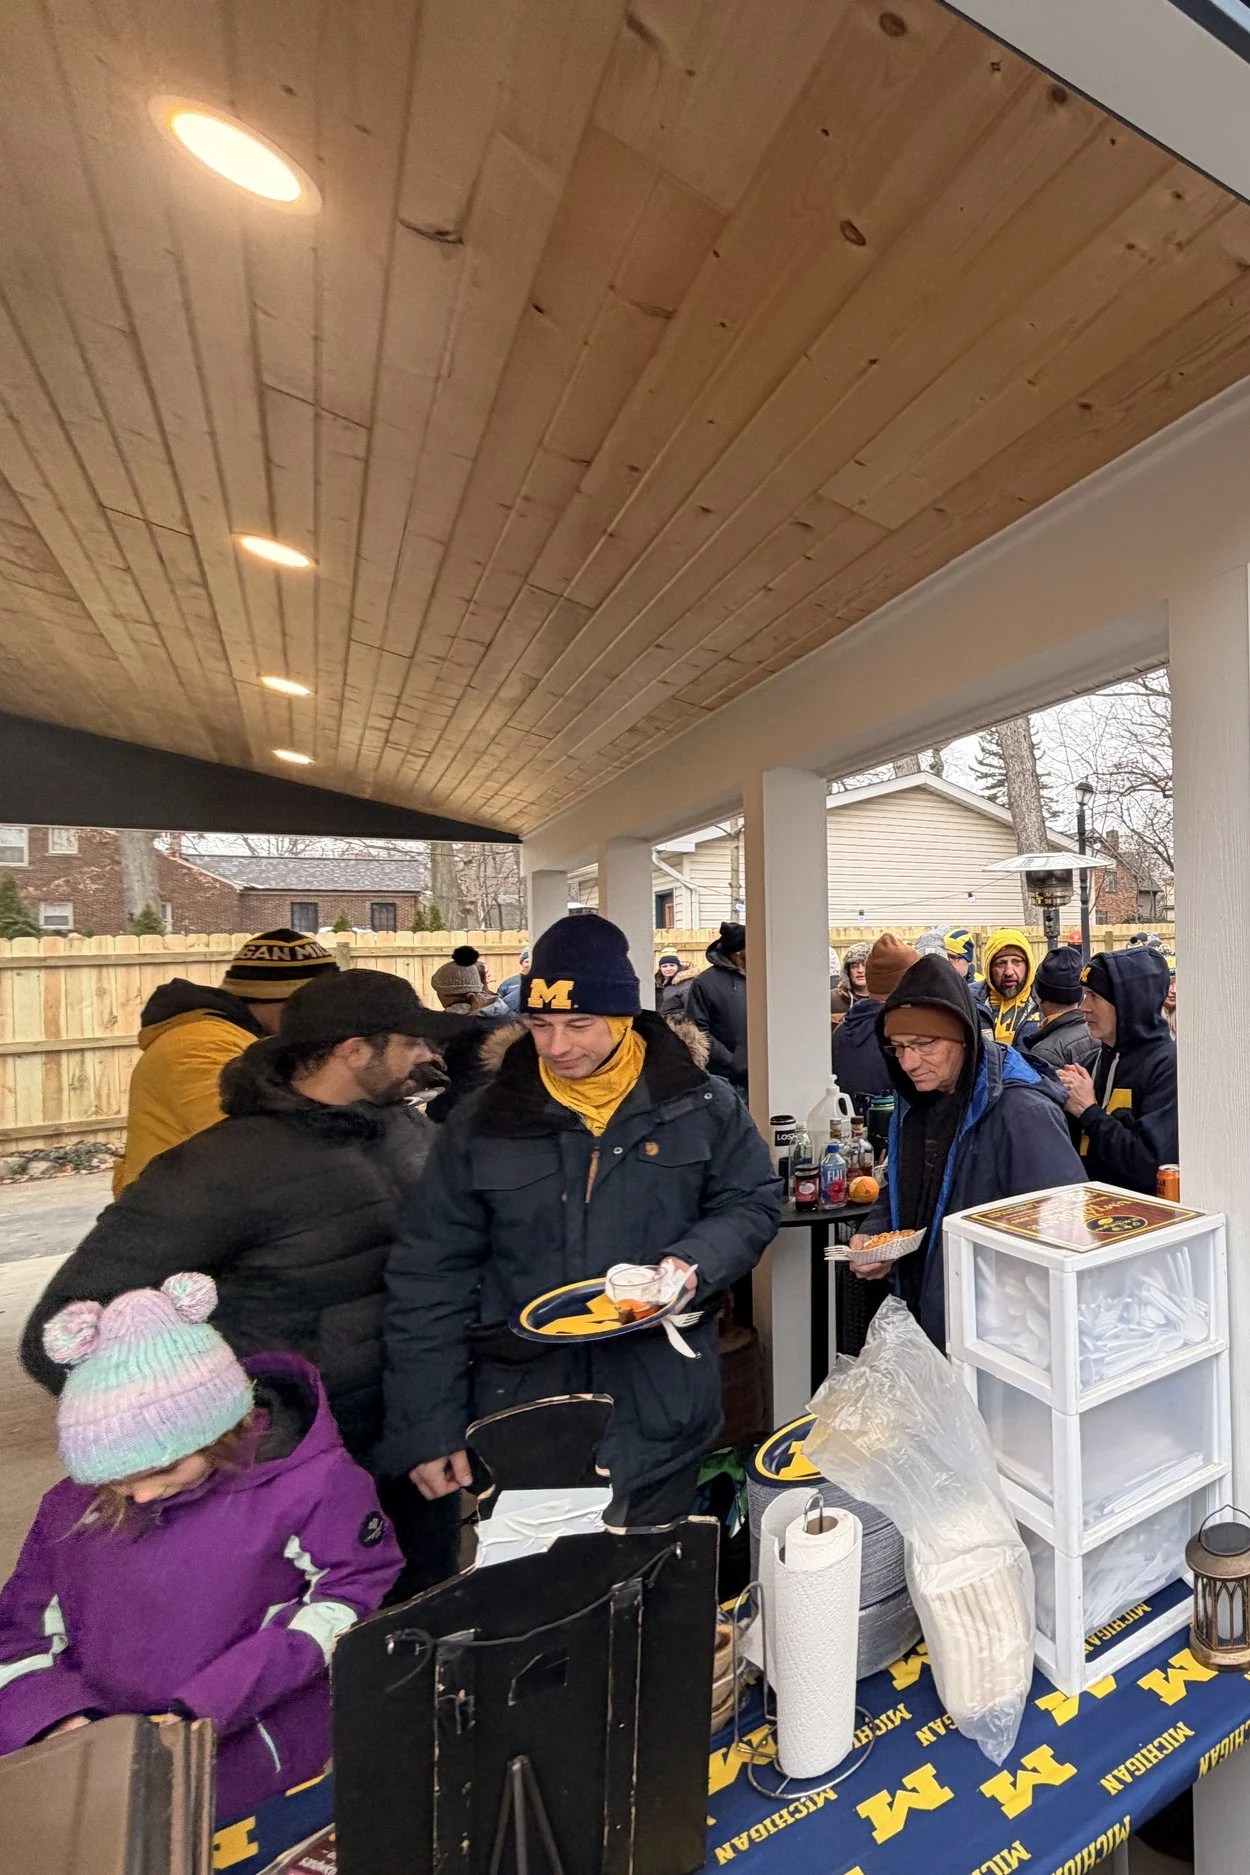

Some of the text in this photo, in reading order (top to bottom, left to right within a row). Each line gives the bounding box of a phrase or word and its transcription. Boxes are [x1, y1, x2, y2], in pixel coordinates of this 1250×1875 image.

[527, 978, 575, 1009] M
[827, 1169, 843, 1182] FIJI
[979, 1744, 1078, 1820] M
[1099, 1721, 1196, 1796] MICHIGAN
[714, 1787, 838, 1866] MICHIGAN
[855, 1763, 955, 1845] M
